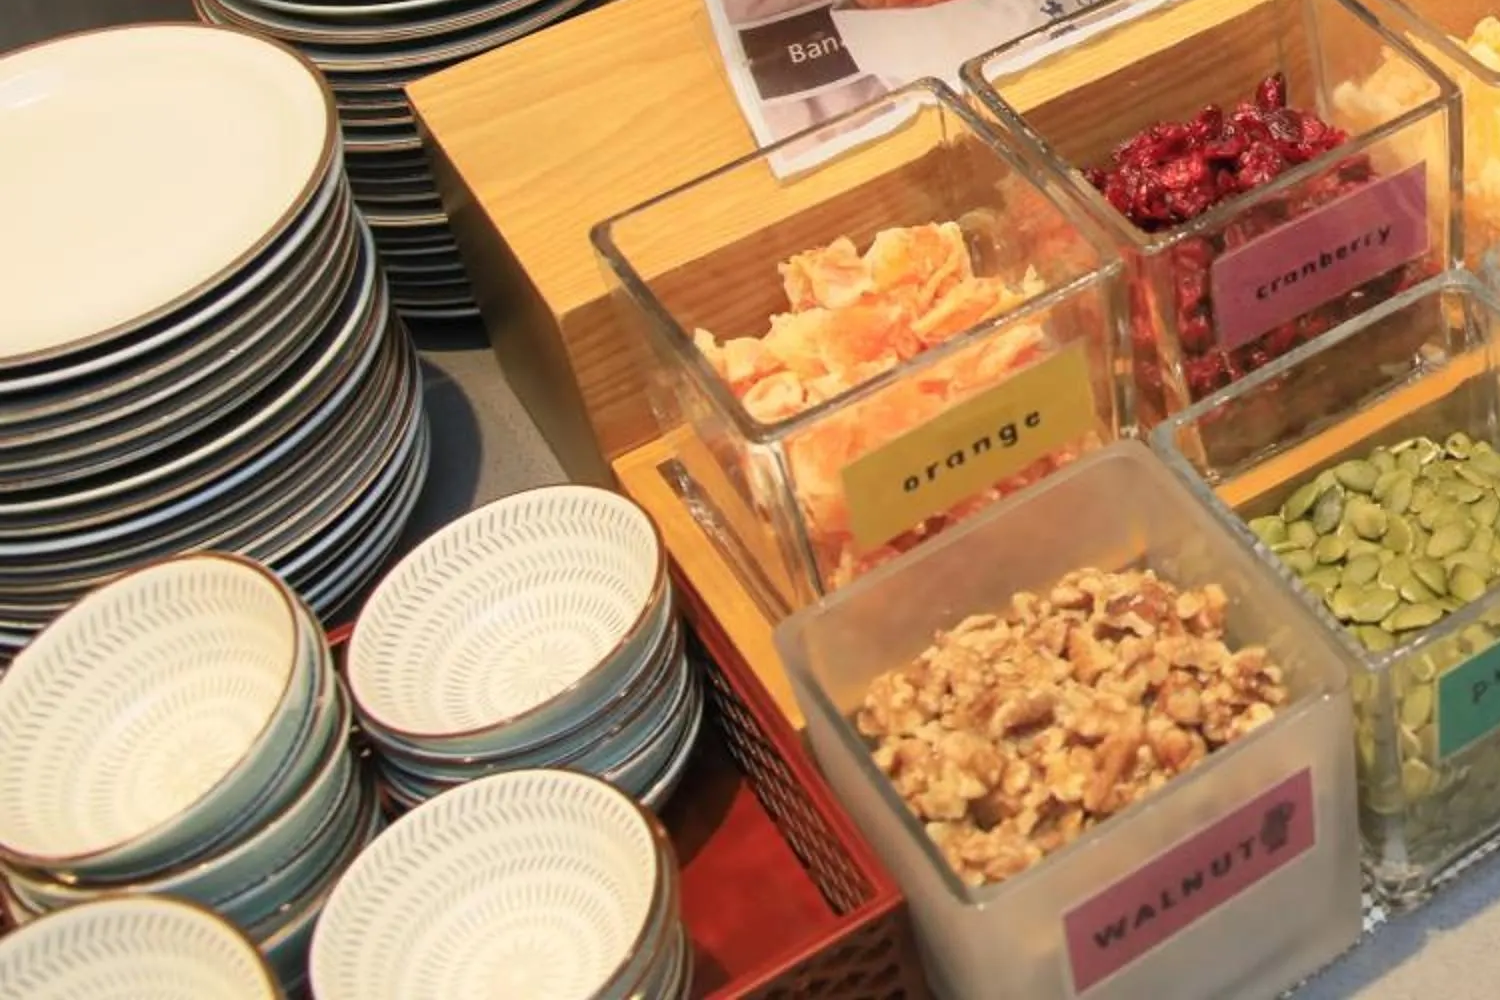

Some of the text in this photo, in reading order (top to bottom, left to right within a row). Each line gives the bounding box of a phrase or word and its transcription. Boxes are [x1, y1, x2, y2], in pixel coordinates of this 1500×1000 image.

[787, 36, 845, 65] Ban
[1256, 224, 1391, 300] cranberry
[903, 410, 1041, 492] orange
[1094, 835, 1256, 948] WALNUT
